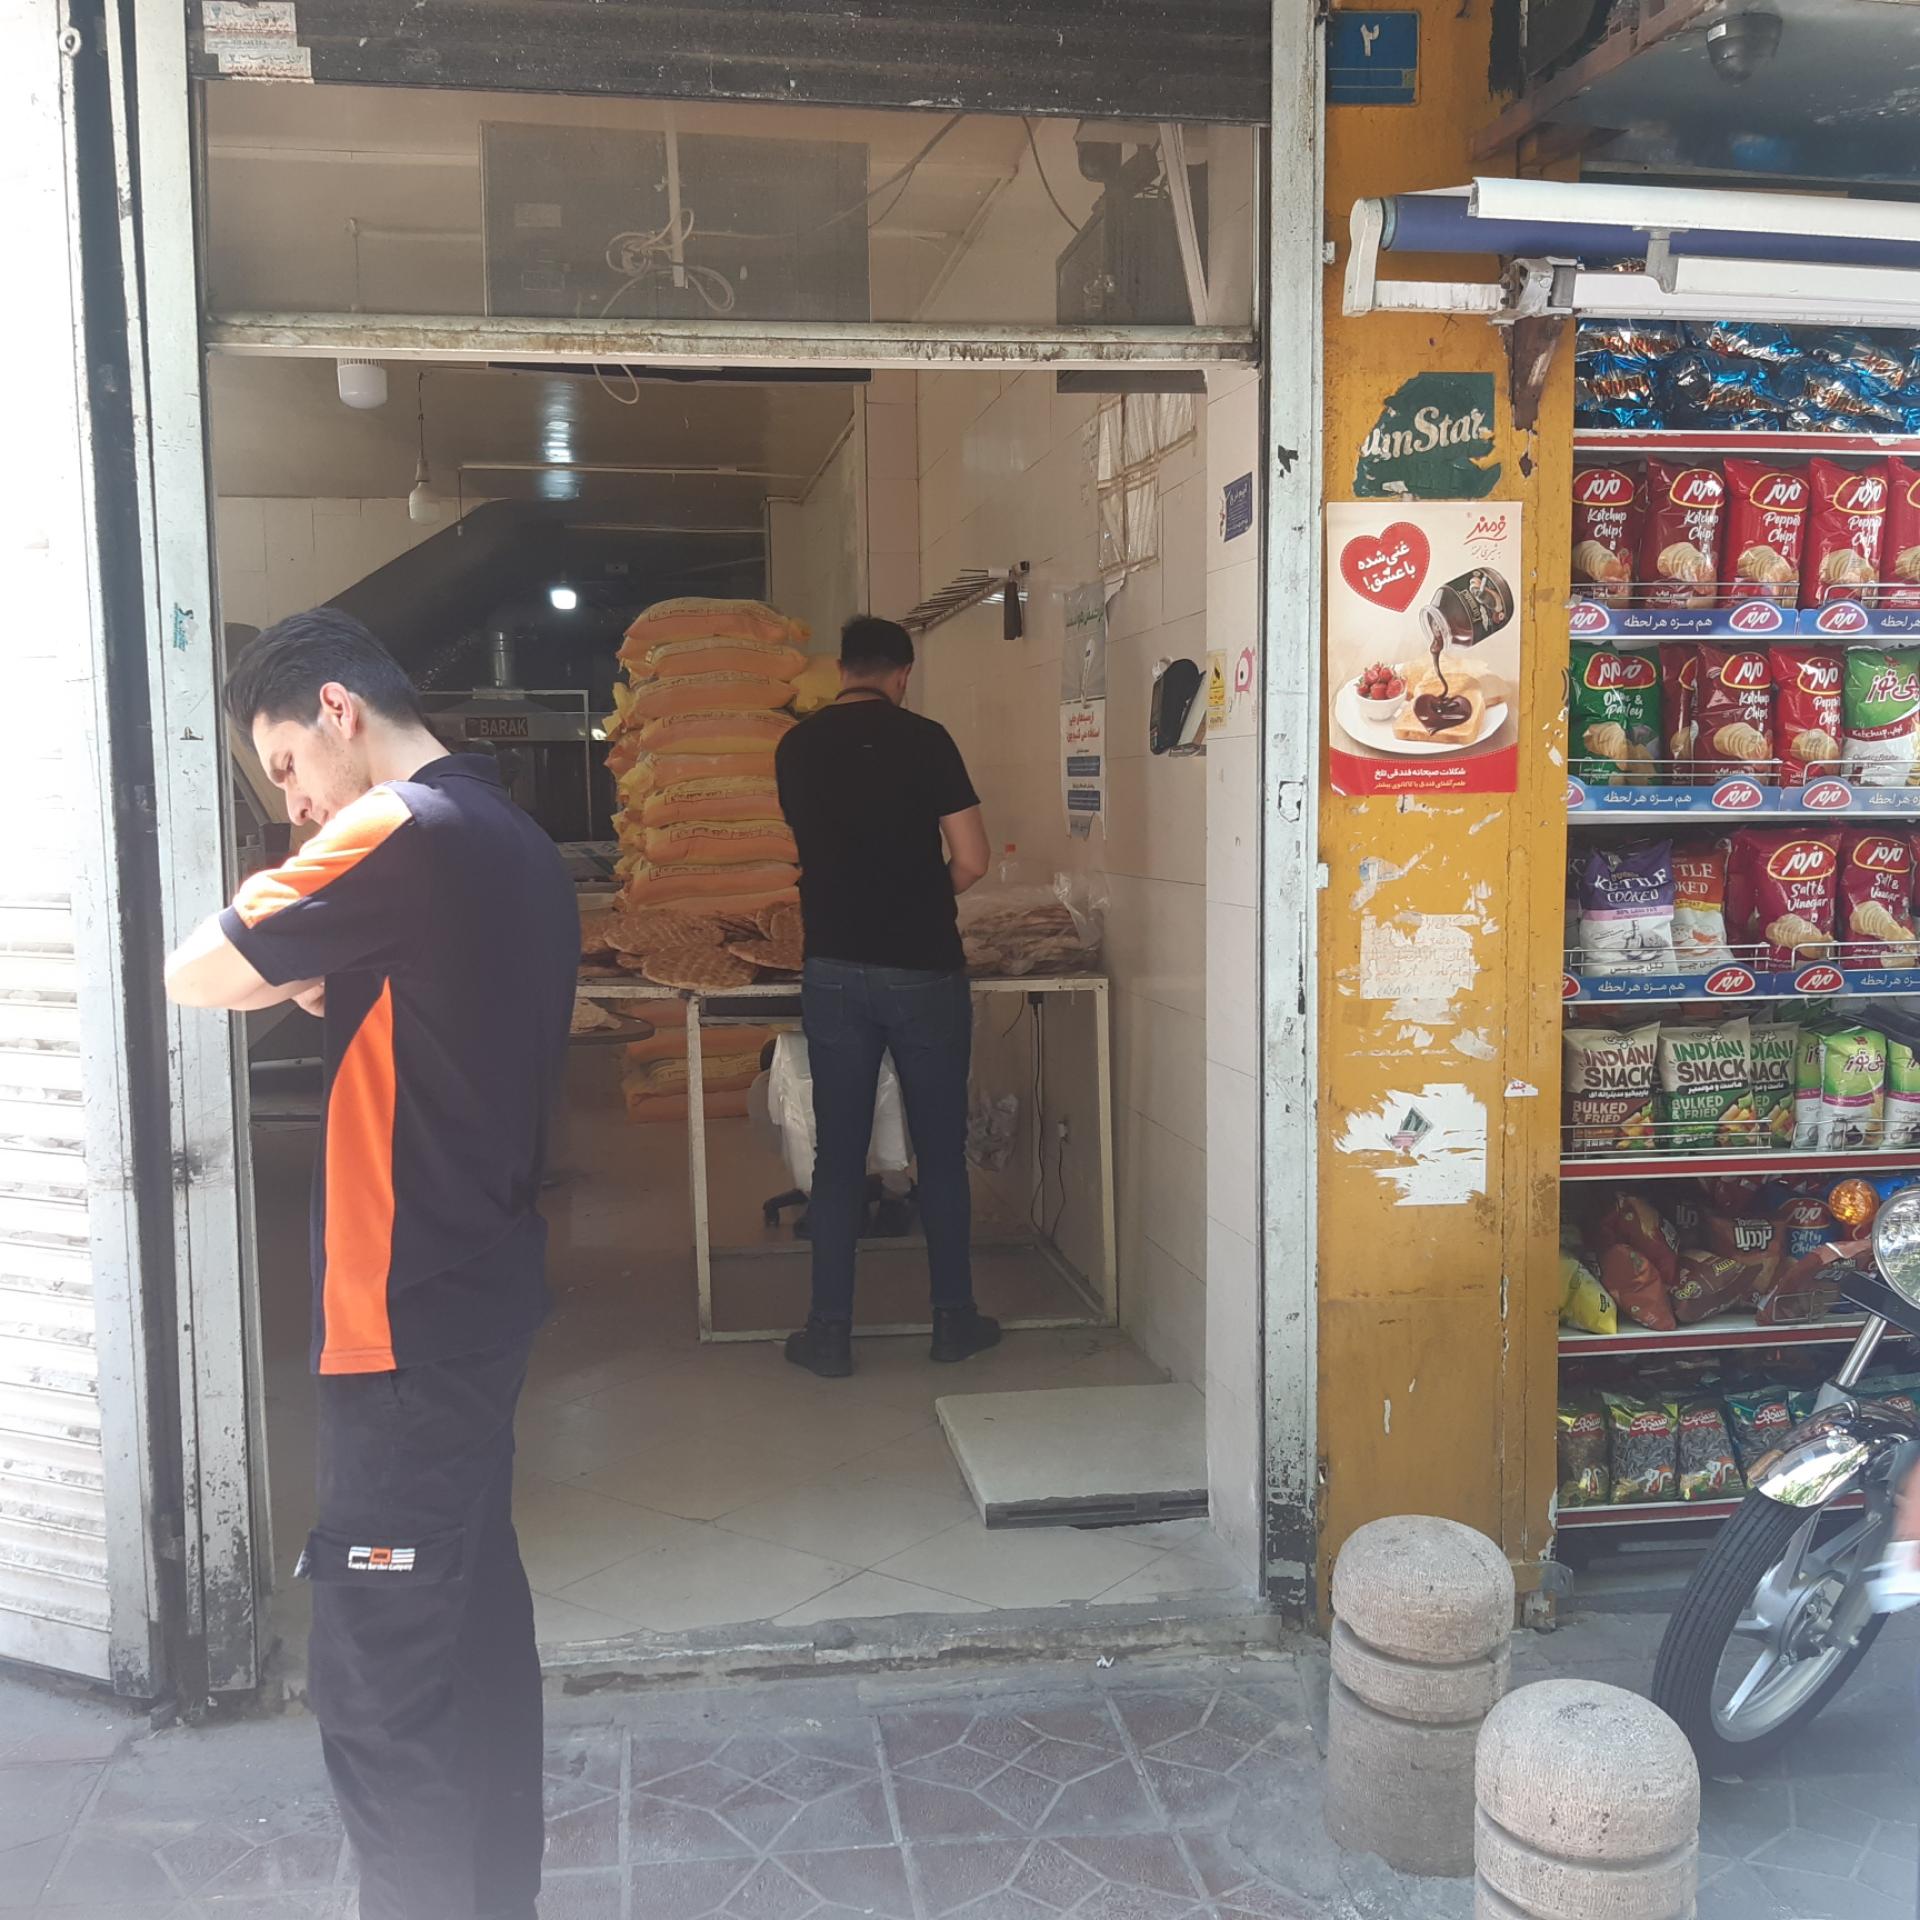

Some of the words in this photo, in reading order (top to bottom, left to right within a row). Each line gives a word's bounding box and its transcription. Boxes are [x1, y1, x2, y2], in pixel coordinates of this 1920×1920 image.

[1361, 23, 1380, 57] ۲
[1583, 473, 1621, 501] مزمز
[1763, 478, 1802, 504] مزمز
[1587, 508, 1627, 524] Ketchup
[1594, 524, 1623, 539] Chips
[1688, 526, 1714, 542] Chips
[1768, 529, 1797, 545] Chips
[1357, 550, 1386, 570] شده
[1386, 540, 1410, 565] غنی
[1403, 560, 1416, 578] با
[1624, 614, 1651, 628] لحظه
[1653, 618, 1667, 631] هر
[1670, 617, 1694, 630] مزه
[1696, 616, 1712, 629] هم
[1738, 606, 1771, 627] مزمز
[1825, 607, 1858, 628] مزمز
[1881, 616, 1907, 627] لحظه
[1734, 656, 1763, 684] مزمز
[1744, 707, 1768, 721] Chips
[480, 719, 527, 736] BARAK
[1387, 768, 1412, 779] فندقی
[1412, 768, 1439, 777] صبحانه
[1439, 767, 1466, 776] شکلات
[1603, 791, 1632, 803] لحظه
[1633, 794, 1647, 806] هر
[1650, 793, 1673, 805] مزه
[1675, 794, 1692, 808] هم
[1720, 786, 1753, 806] مزمز
[1810, 786, 1842, 806] مزمز
[1869, 792, 1896, 805] لحظه
[1897, 795, 1911, 807] هر
[1781, 845, 1825, 876] مزمز
[1867, 842, 1904, 865] مزمز
[1594, 868, 1668, 892] KETTLE
[1607, 888, 1659, 904] COOKED
[1791, 881, 1816, 899] Salt
[1787, 897, 1829, 912] Vinegar
[1598, 980, 1625, 992] لحظه
[1643, 981, 1667, 993] مزه
[1713, 970, 1744, 991] مزمز
[1803, 970, 1835, 990] مزمز
[1860, 973, 1887, 985] لحظه
[1888, 976, 1901, 988] هر
[1626, 984, 1641, 995] هر
[1669, 982, 1686, 995] هم
[1583, 1044, 1654, 1067] INDIAN!
[1672, 1039, 1745, 1061] INDIAN!
[1750, 1039, 1793, 1060] DIAN!
[1584, 1066, 1653, 1088] SNACK
[1677, 1058, 1748, 1083] SNACK
[1750, 1060, 1790, 1081] NACK
[1720, 1081, 1742, 1090] ماست
[1573, 1101, 1627, 1114] BULKED
[1672, 1095, 1724, 1110] BULKED
[1585, 1114, 1620, 1124] FRIED
[1672, 1109, 1680, 1120] &
[1684, 1108, 1719, 1119] FRIED
[1789, 1202, 1822, 1223] مزمز
